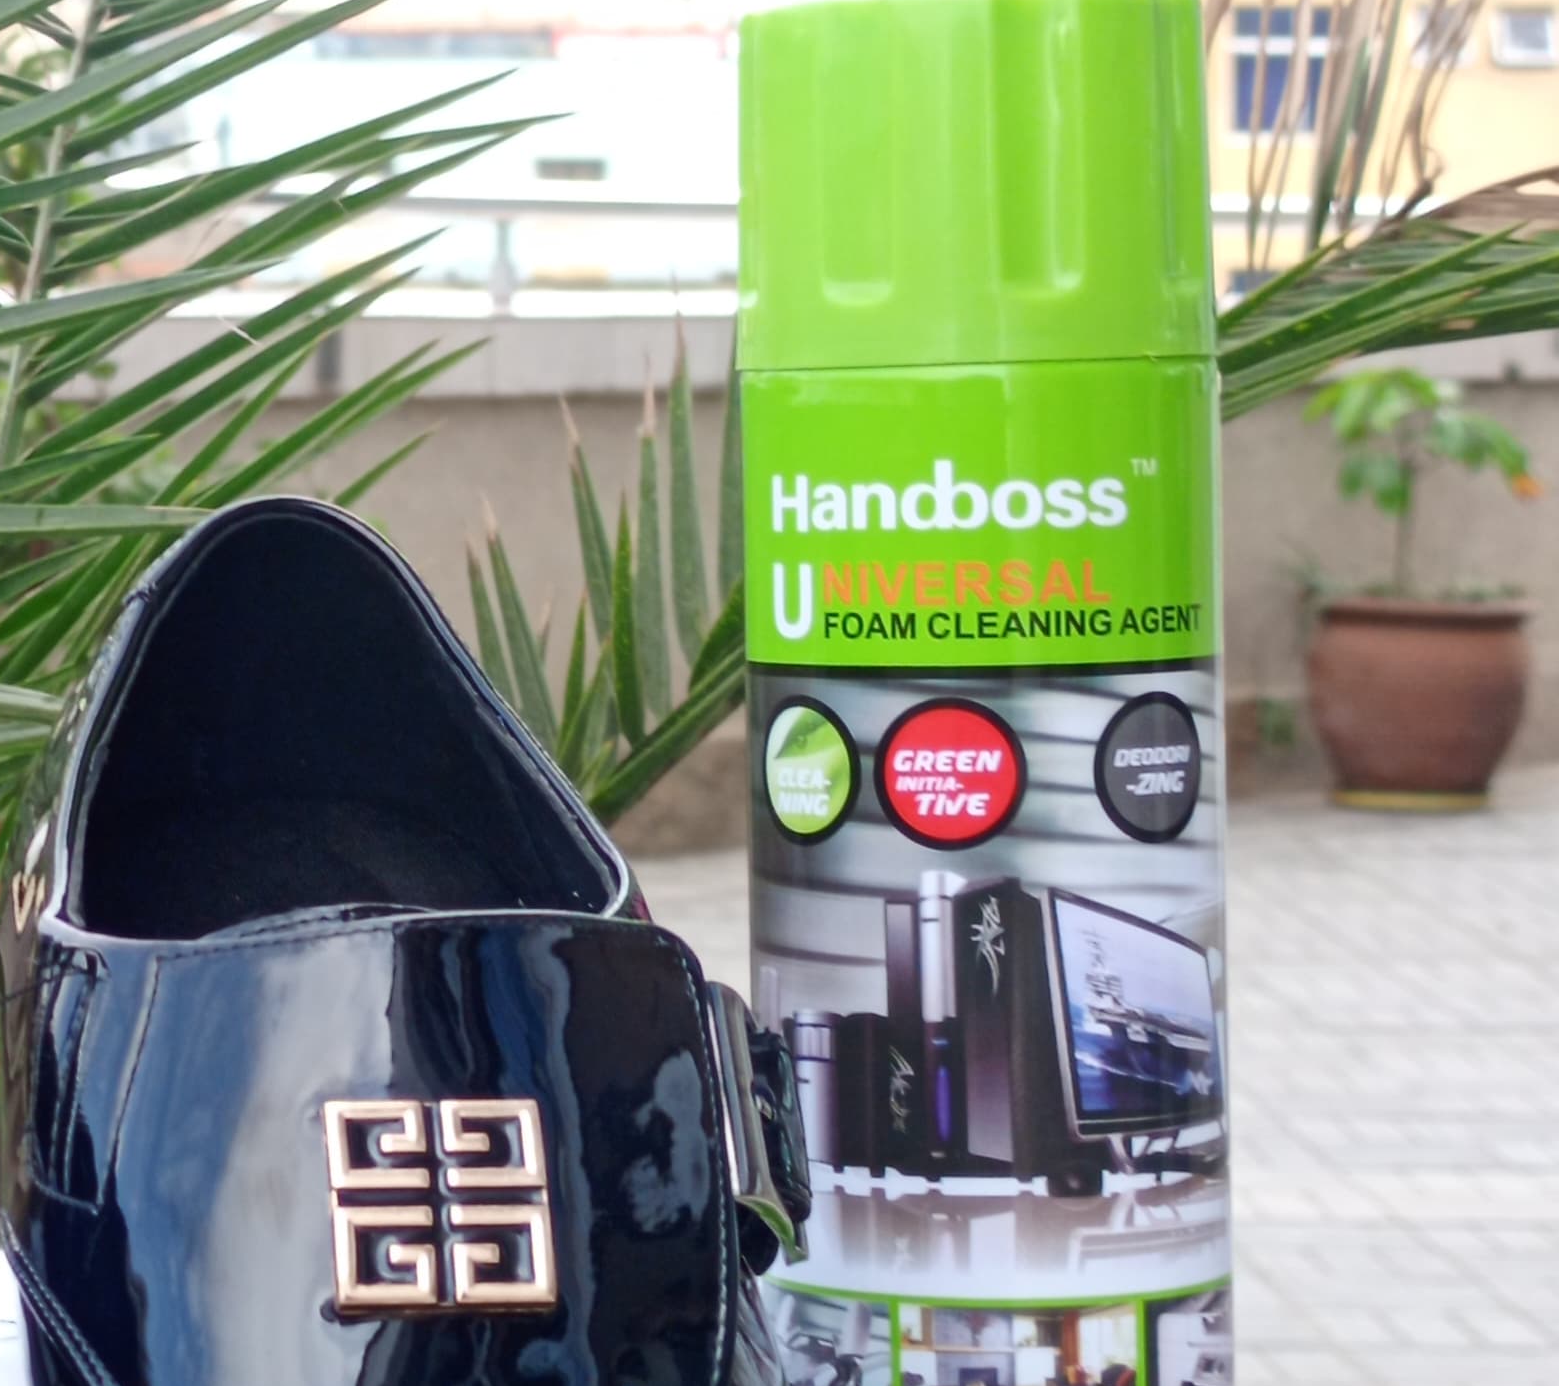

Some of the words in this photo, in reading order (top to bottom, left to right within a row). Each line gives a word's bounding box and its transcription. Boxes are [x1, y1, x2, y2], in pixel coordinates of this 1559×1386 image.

[772, 459, 1128, 532] Handboss
[773, 560, 1111, 639] UNIVERSAL
[824, 611, 917, 639] FOAM
[928, 610, 1111, 639] CLEANING
[1120, 604, 1201, 635] AGENT
[893, 749, 1002, 772] GREEN
[895, 776, 964, 791] INITIA-
[1126, 771, 1185, 795] -ZING
[778, 791, 830, 816] NING
[915, 793, 989, 816] TIVE
